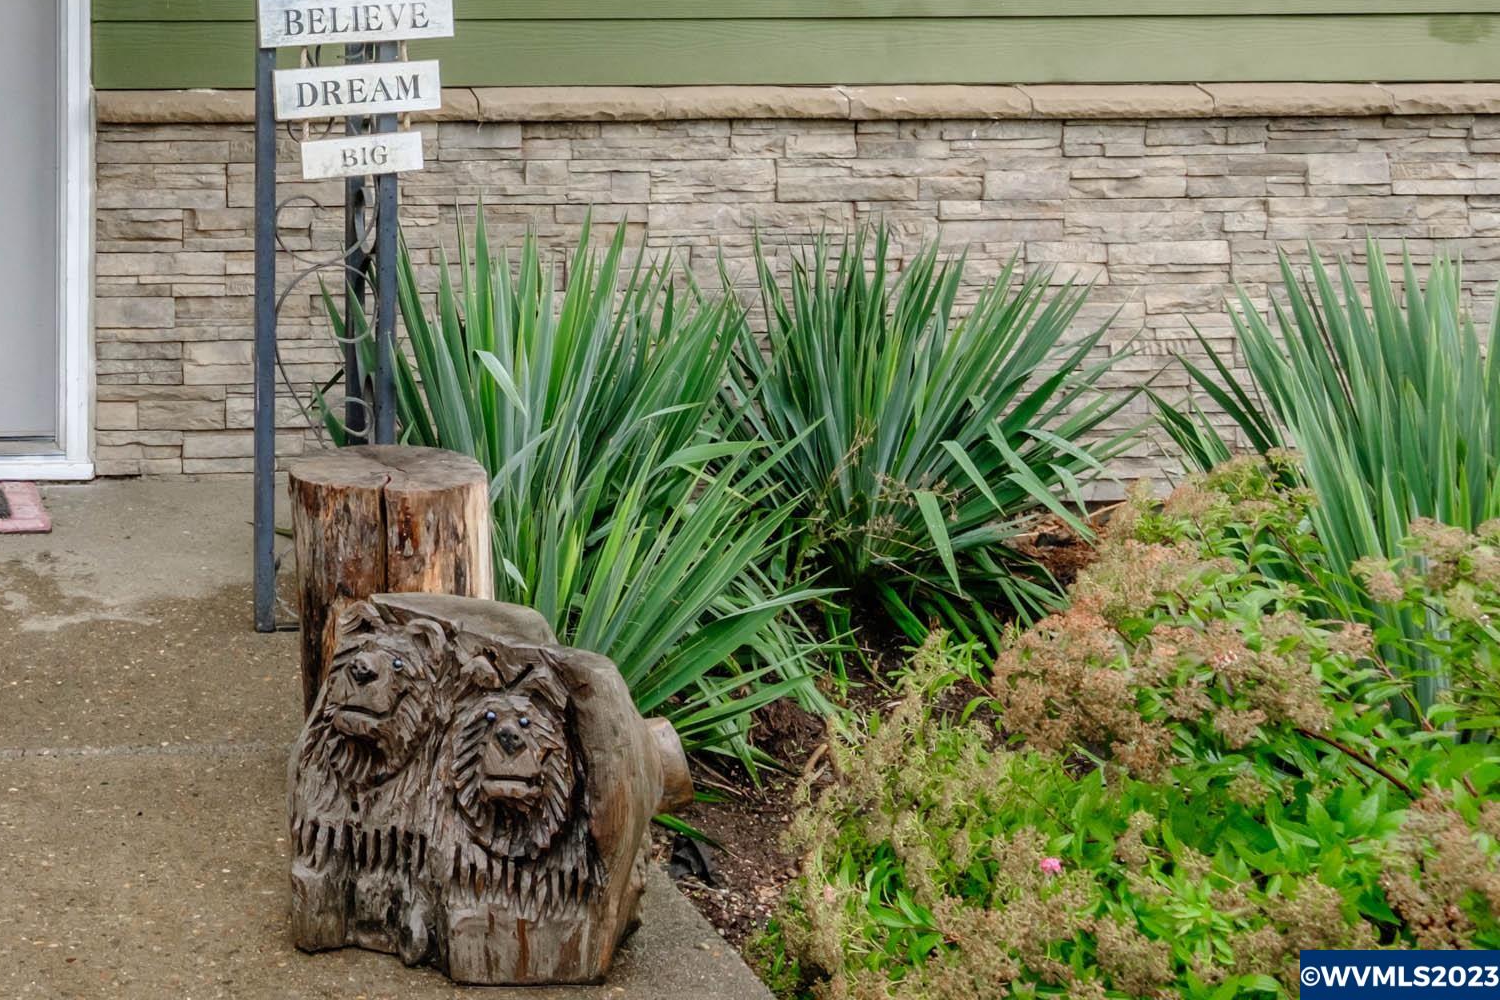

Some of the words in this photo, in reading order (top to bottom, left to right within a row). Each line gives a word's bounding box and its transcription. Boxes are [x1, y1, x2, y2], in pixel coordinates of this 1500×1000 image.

[283, 2, 429, 36] BELIEVE
[296, 73, 422, 108] DREAM
[341, 145, 389, 168] BIG
